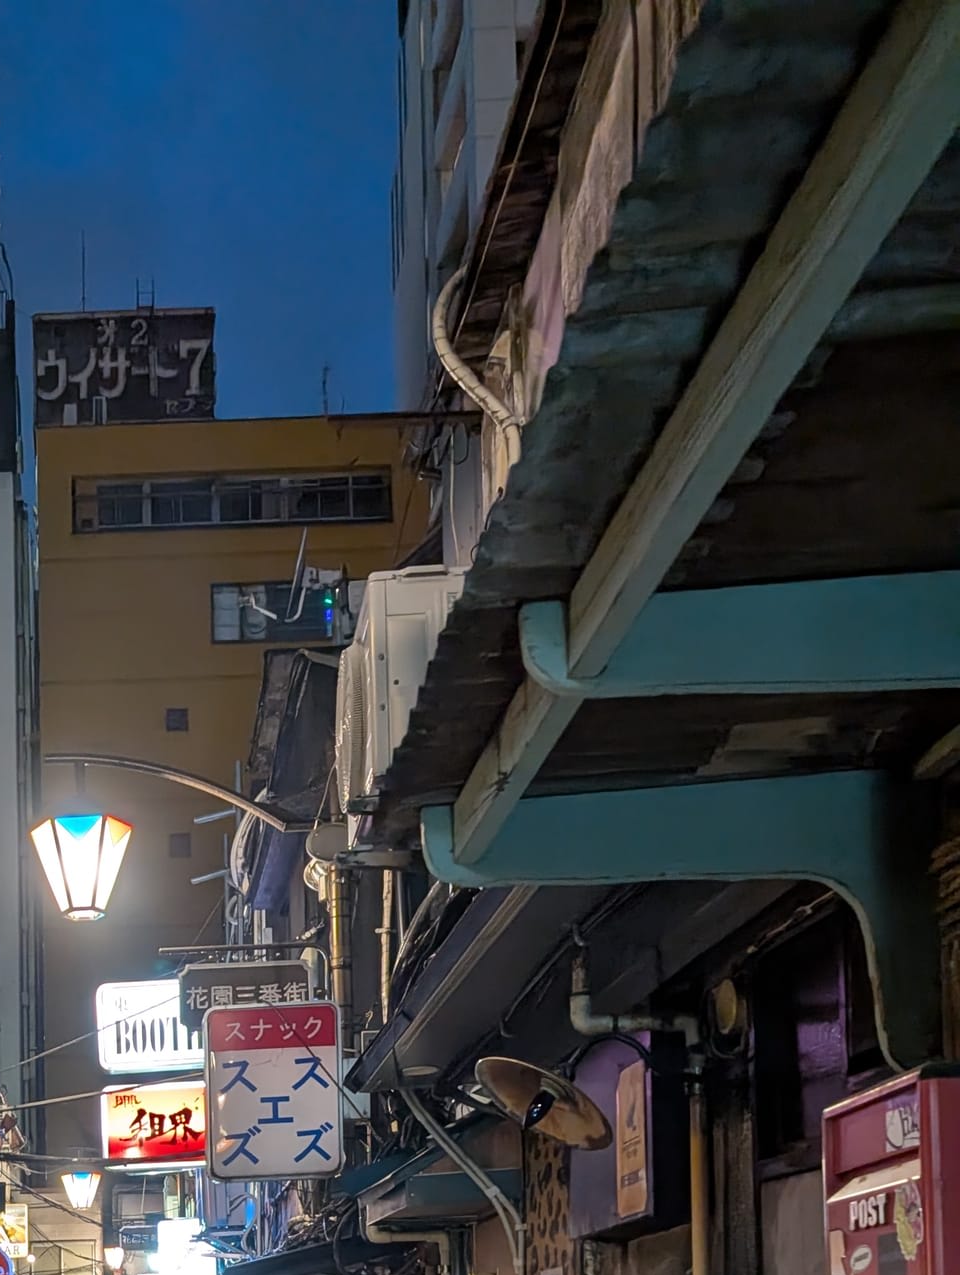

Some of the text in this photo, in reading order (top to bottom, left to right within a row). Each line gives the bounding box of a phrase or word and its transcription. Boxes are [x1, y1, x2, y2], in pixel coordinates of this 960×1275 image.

[185, 981, 308, 1010] 花園三番街
[225, 1016, 323, 1042] スナック
[119, 1107, 205, 1147] 租界
[849, 1193, 886, 1231] POST
